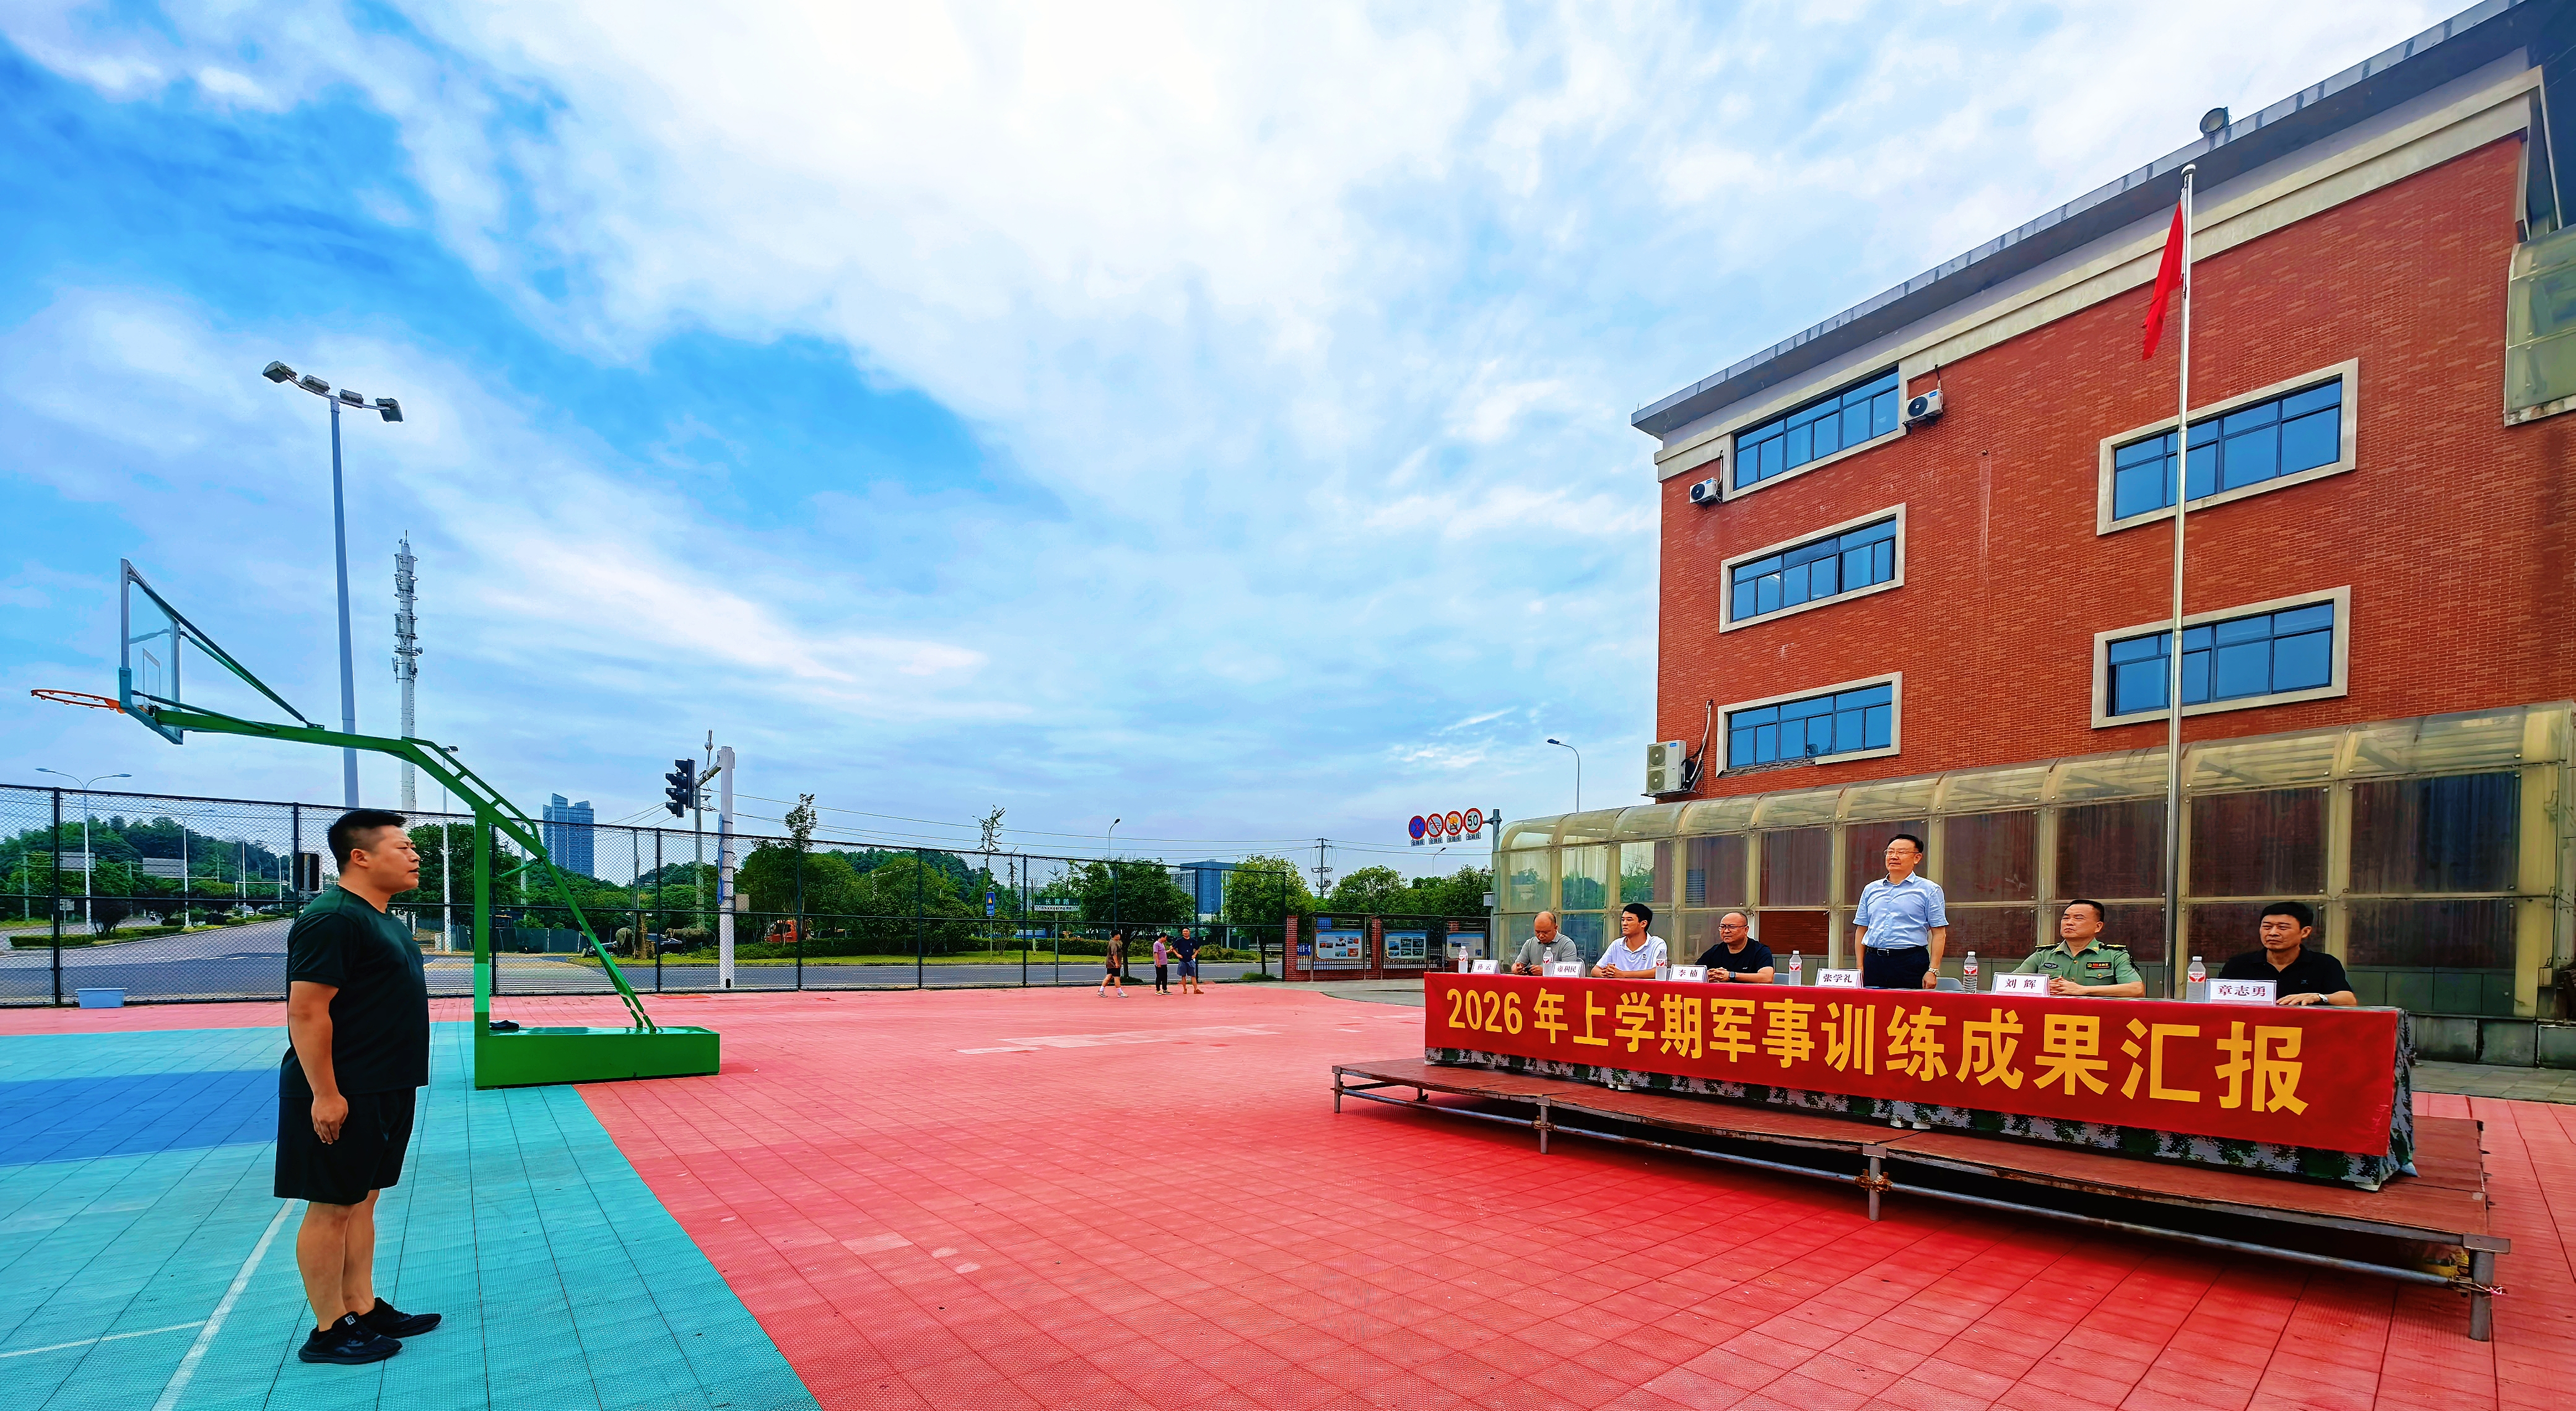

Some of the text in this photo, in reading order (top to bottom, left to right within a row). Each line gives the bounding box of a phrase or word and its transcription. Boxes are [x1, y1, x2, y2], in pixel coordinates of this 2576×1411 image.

[1468, 815, 1478, 827] 50
[1823, 974, 1852, 983] 张学礼
[2004, 978, 2037, 989] 刘辉
[2218, 984, 2266, 997] 章志勇
